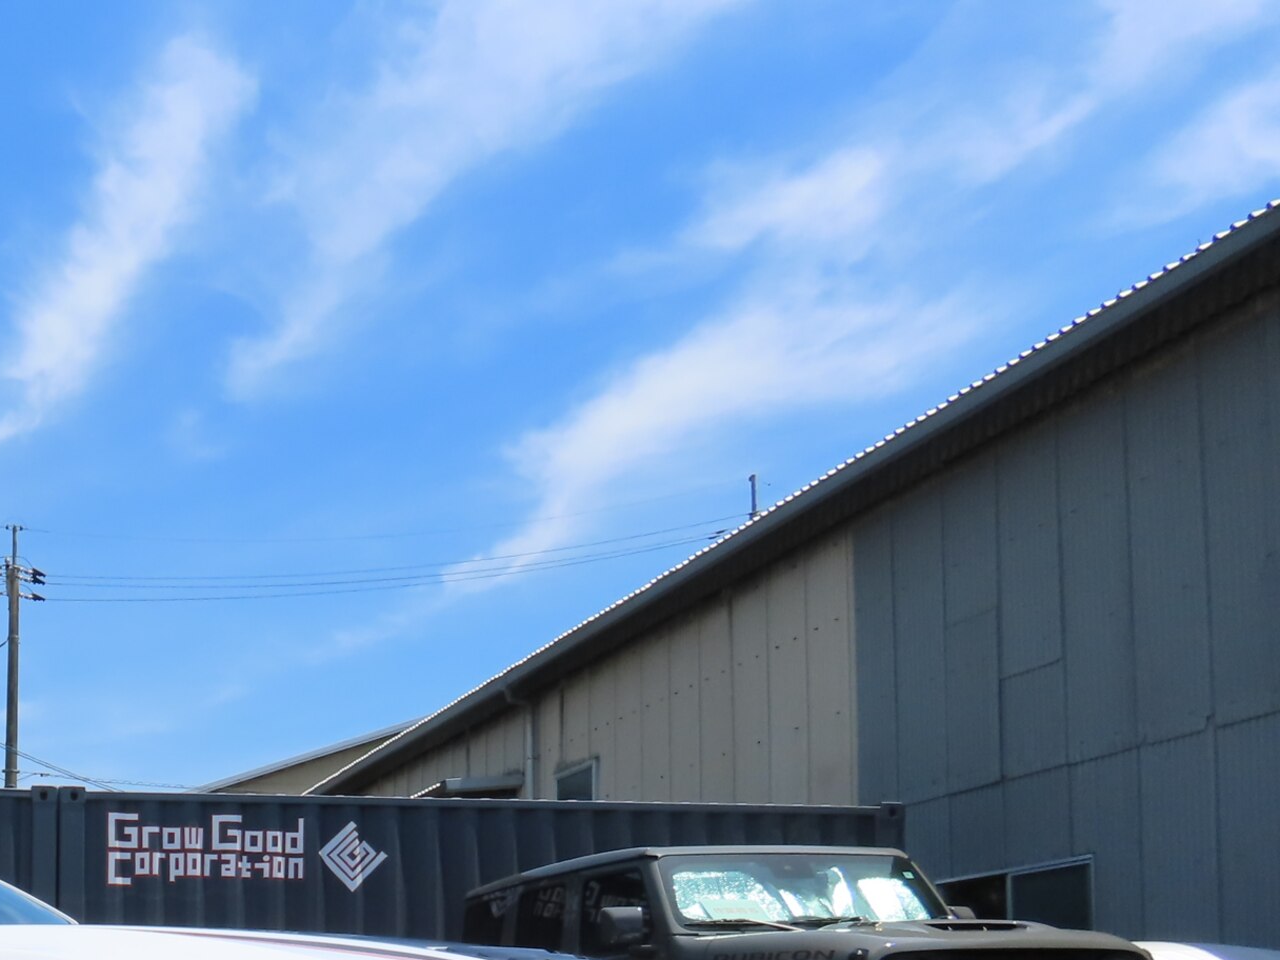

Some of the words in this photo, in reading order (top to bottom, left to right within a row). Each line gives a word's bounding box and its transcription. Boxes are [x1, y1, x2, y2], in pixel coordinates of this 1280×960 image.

[106, 811, 205, 850] Grow
[211, 814, 306, 855] Good
[106, 850, 306, 886] Corporation
